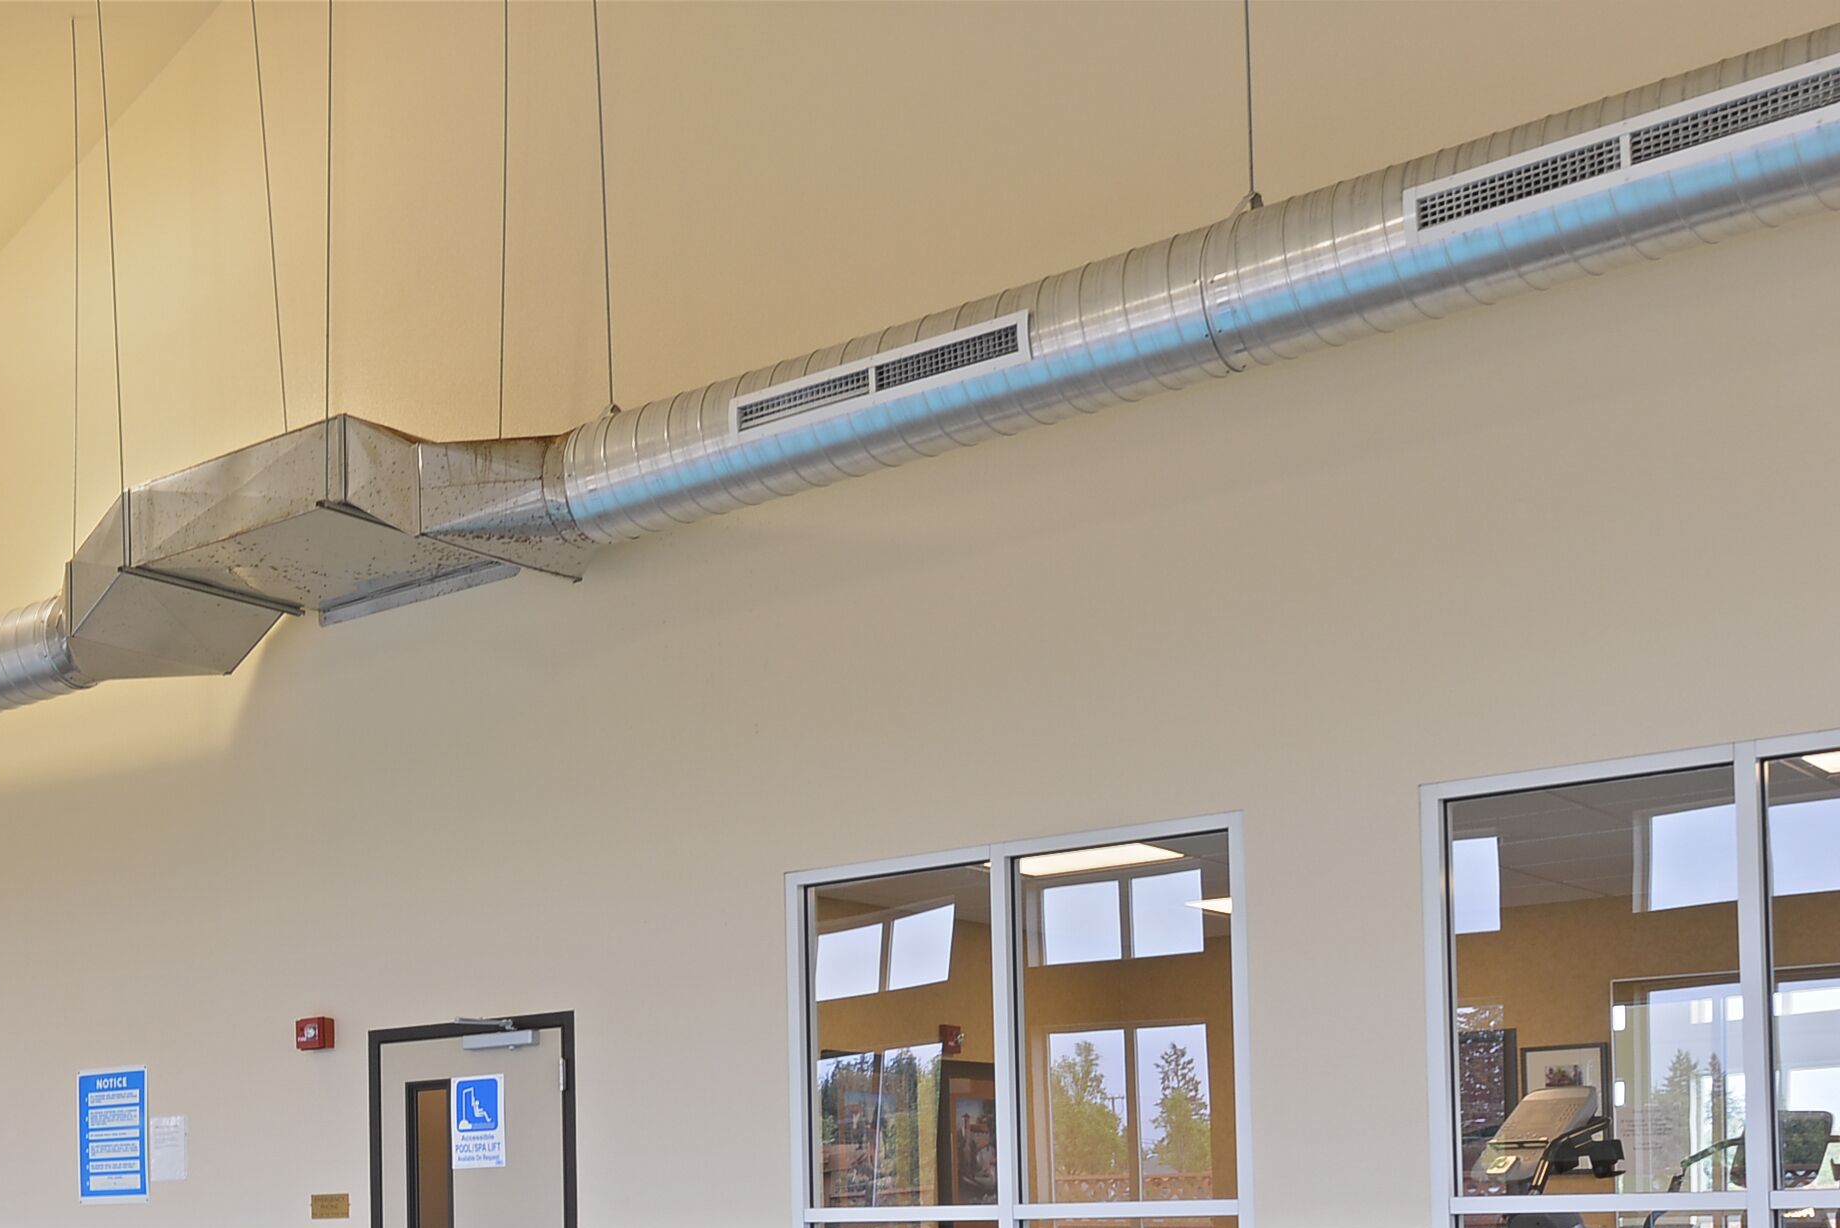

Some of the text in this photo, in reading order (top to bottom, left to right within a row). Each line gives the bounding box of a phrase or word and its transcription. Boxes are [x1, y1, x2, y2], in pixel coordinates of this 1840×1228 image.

[96, 1077, 127, 1089] NOTICE
[455, 1142, 501, 1153] POOL/SPA LIFT
